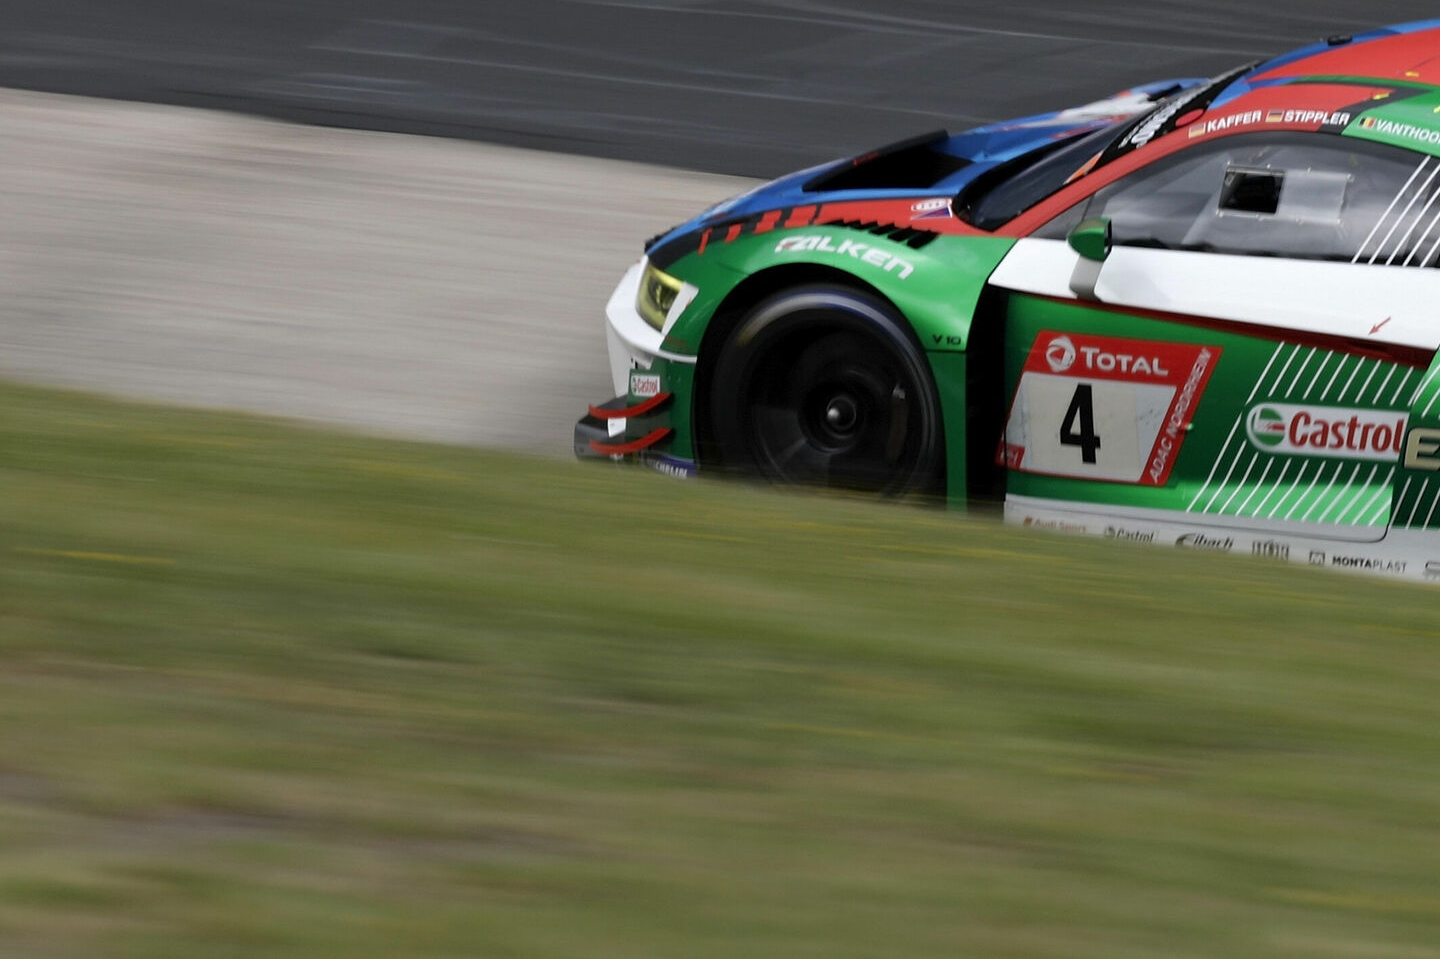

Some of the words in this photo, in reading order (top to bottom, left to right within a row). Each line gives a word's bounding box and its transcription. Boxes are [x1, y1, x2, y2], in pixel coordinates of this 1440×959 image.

[1206, 109, 1262, 133] KAFFER
[1284, 109, 1350, 126] STIPPLER
[774, 235, 915, 280] FALKEN
[946, 336, 962, 346] 10
[1080, 346, 1169, 377] TOTAL
[1059, 382, 1101, 465] 4
[1287, 410, 1407, 455] Castrol
[1149, 437, 1173, 485] ADAC
[1332, 554, 1408, 574] MONTAPLAST
